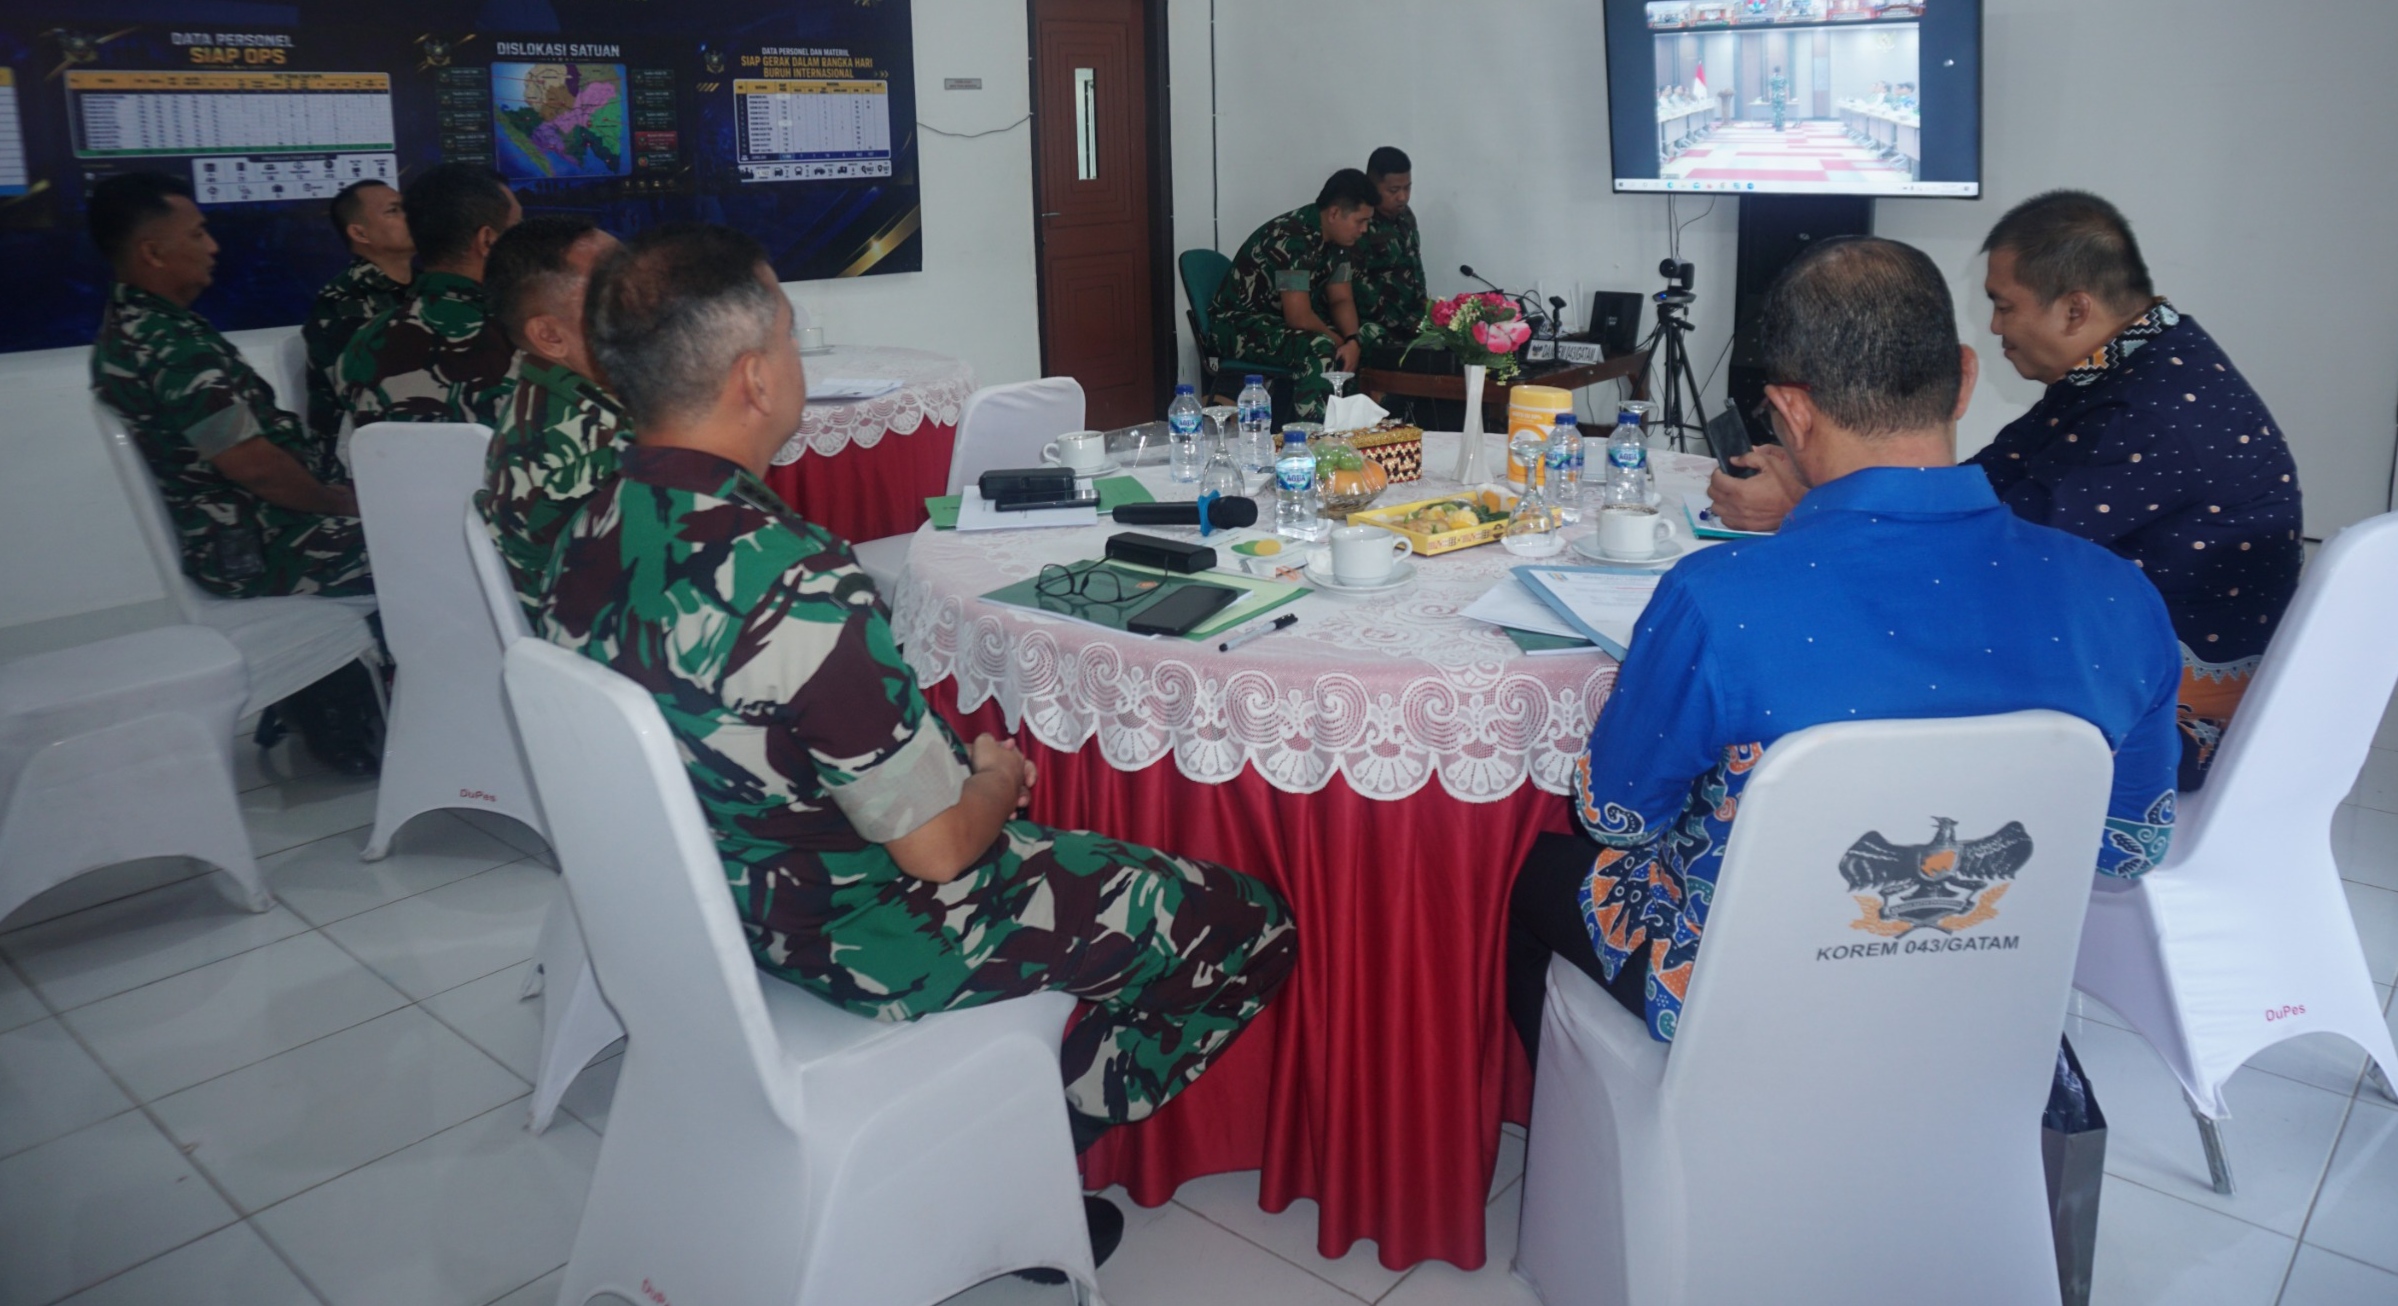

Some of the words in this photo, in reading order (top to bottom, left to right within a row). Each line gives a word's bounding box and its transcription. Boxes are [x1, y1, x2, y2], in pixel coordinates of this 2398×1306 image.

[170, 32, 214, 45] DATA
[215, 34, 295, 47] PERSONEL
[189, 47, 240, 63] SIAP
[244, 48, 286, 64] OPS
[497, 42, 567, 56] DISLOKASI
[569, 44, 620, 57] SATUAN
[761, 47, 778, 55] DATA
[778, 47, 809, 56] PERSONEL
[810, 48, 823, 56] DAN
[740, 56, 761, 67] SIAP
[762, 56, 791, 67] GERAK
[792, 57, 820, 68] DALAM
[821, 58, 854, 68] RANGKA
[855, 58, 873, 68] HARI
[763, 67, 791, 78] BURUH
[793, 68, 854, 78] INTERNASIONAL
[459, 788, 496, 802] DuPes
[1816, 941, 1899, 961] KOREM
[1904, 935, 2020, 954] 043/GATAM
